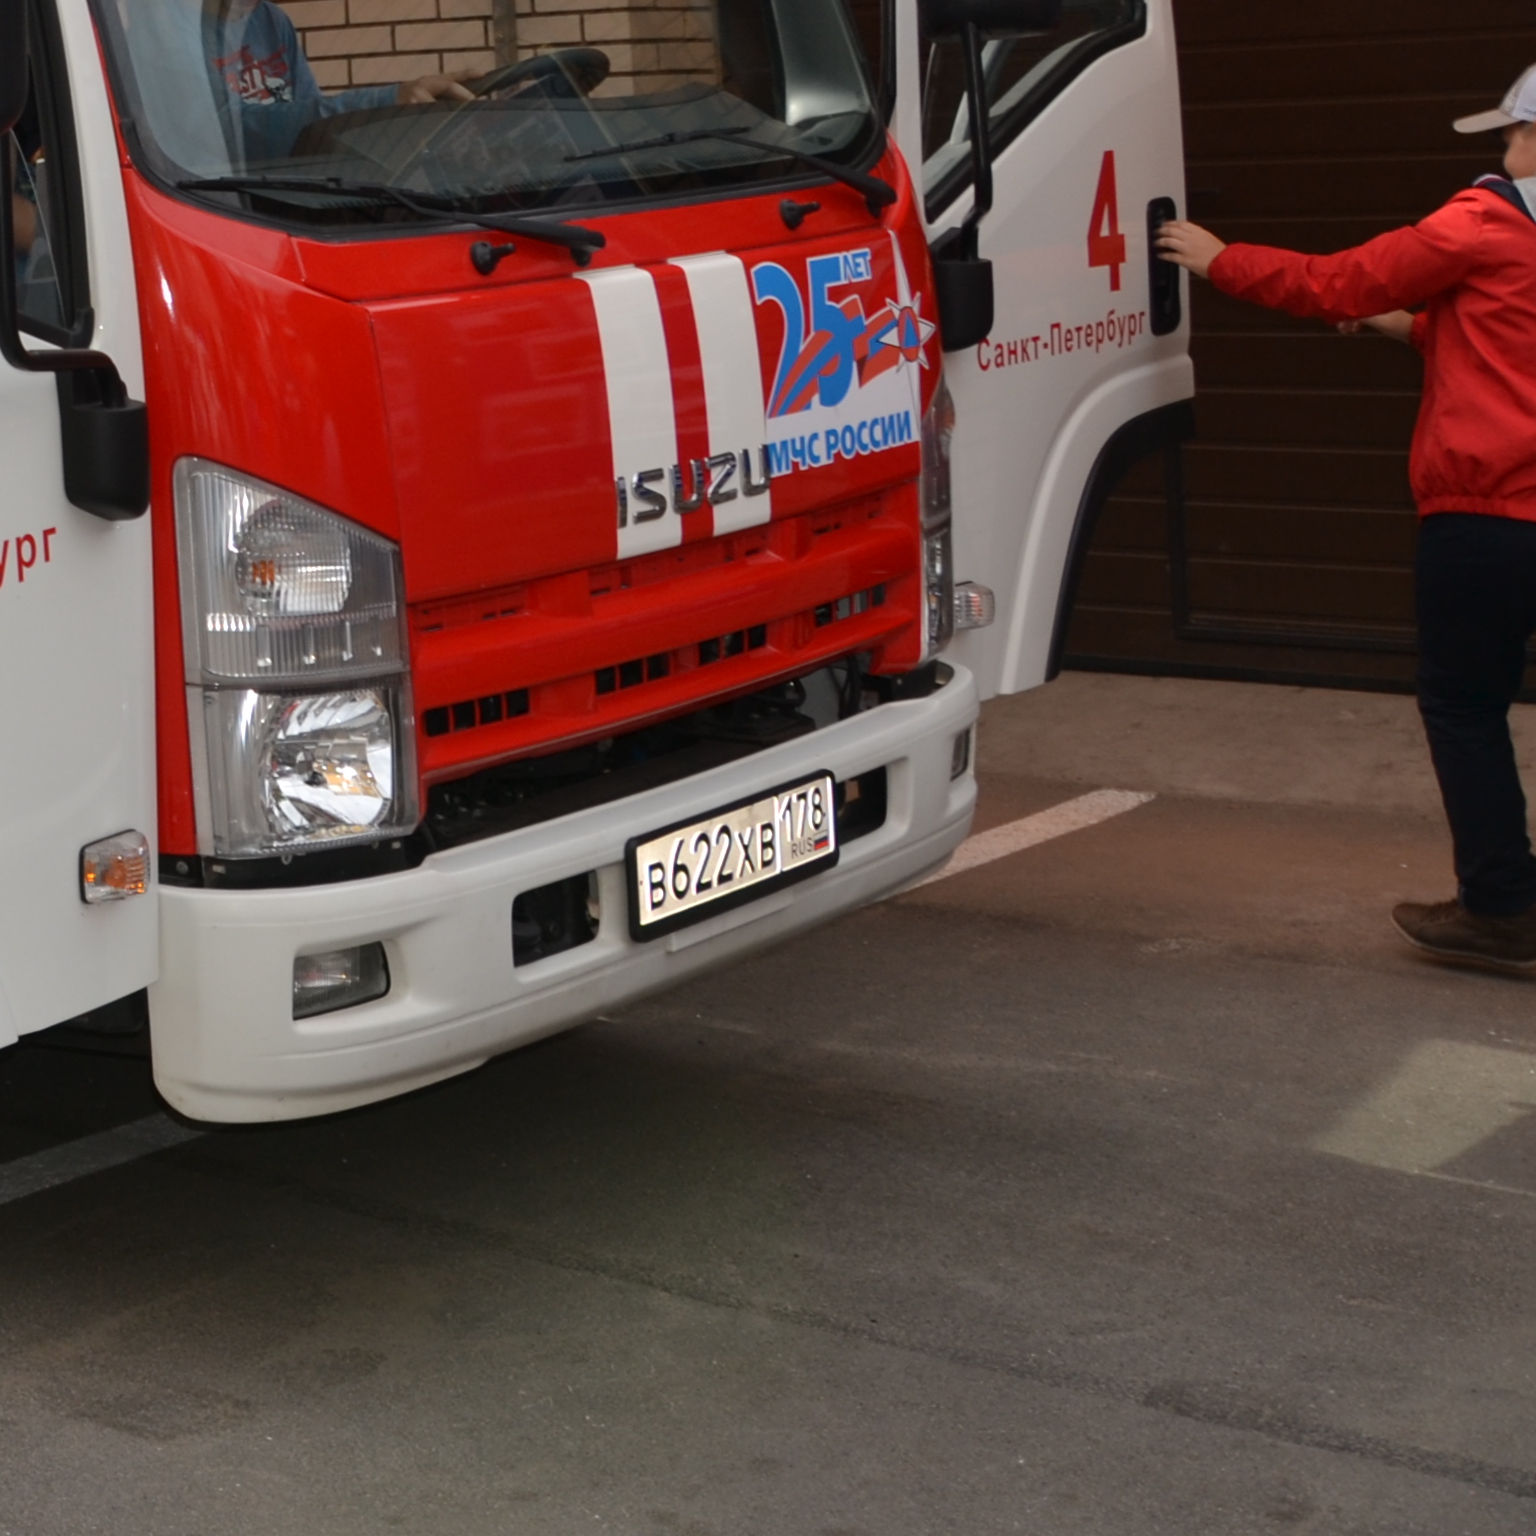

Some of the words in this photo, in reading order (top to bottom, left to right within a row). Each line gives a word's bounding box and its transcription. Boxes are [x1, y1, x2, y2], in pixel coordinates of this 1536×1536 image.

[1087, 149, 1126, 292] 4
[751, 256, 866, 418] 25
[842, 249, 871, 282] ЛЕТ
[976, 309, 1146, 372] Санкт-Петербург
[767, 431, 824, 477] МЧС
[825, 409, 914, 467] РОССИИ
[615, 443, 772, 530] ISUZU
[778, 785, 826, 843] 178
[790, 836, 815, 861] RUS
